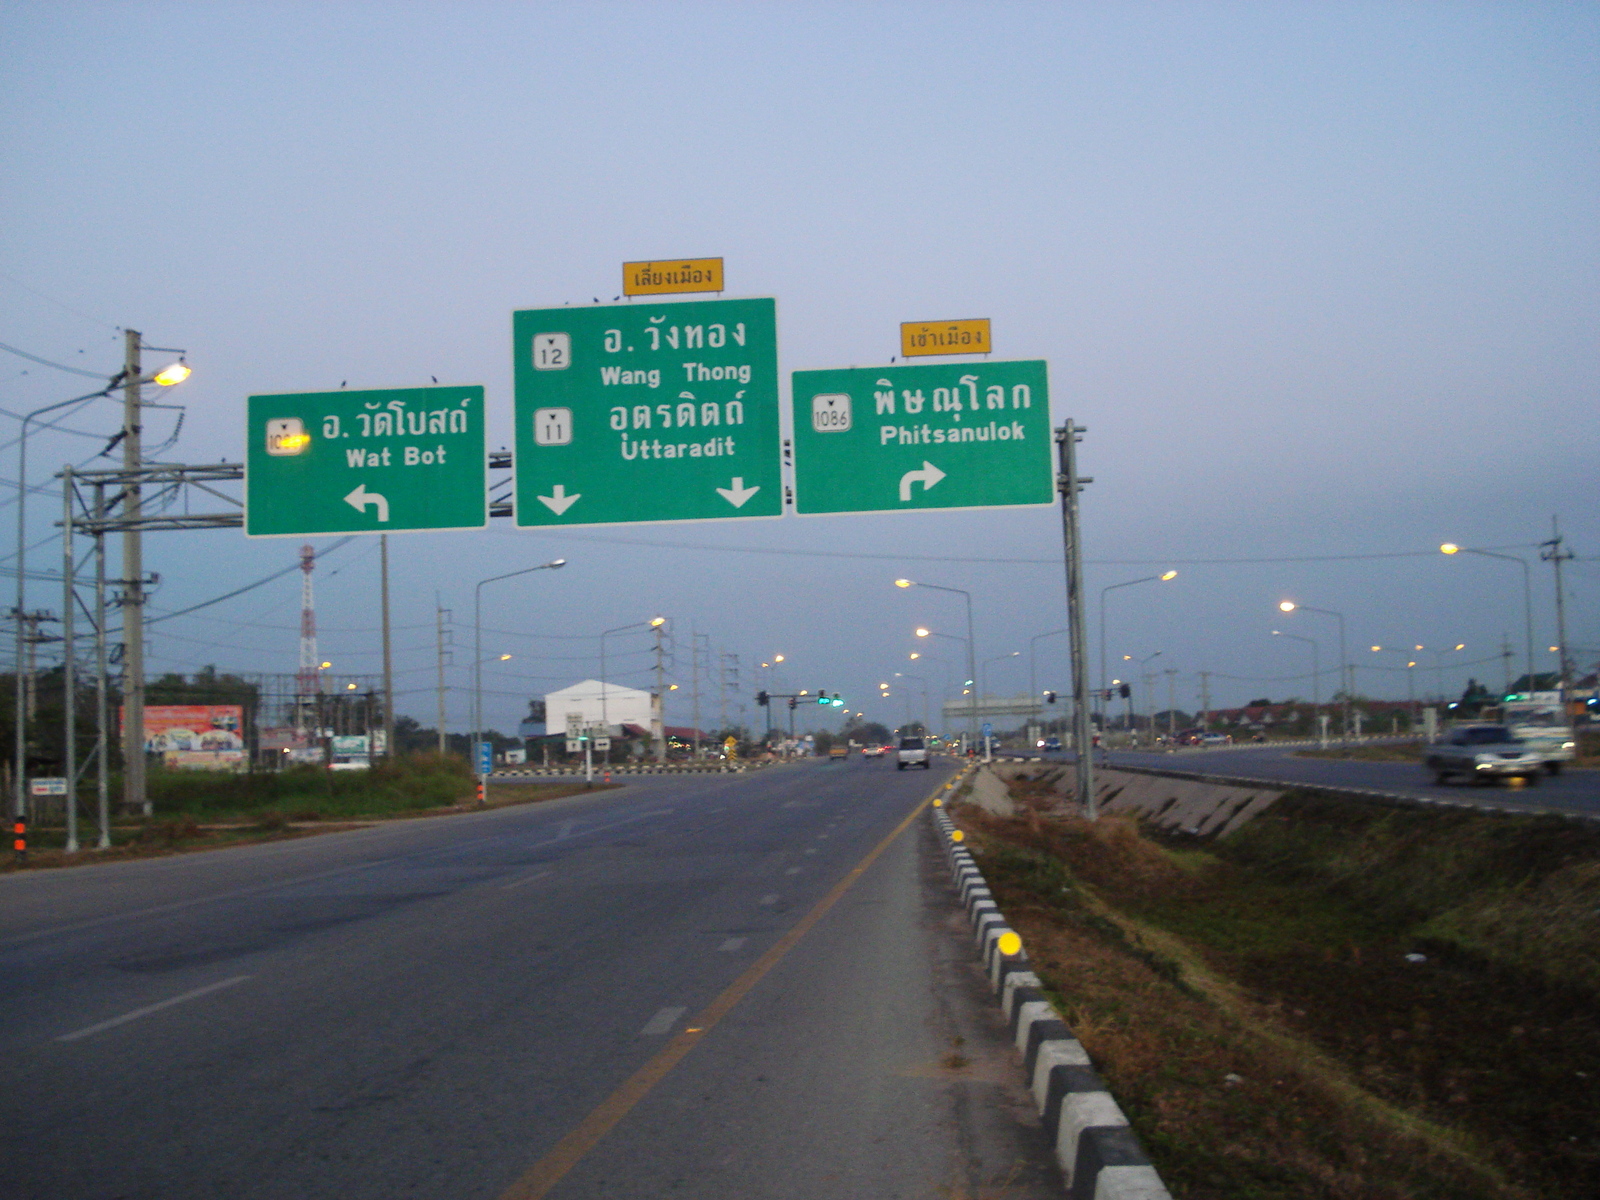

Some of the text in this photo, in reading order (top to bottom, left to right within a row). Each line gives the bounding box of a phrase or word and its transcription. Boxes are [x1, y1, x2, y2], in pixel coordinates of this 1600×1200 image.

[634, 263, 712, 286] เลี่ยงเมือง
[604, 315, 746, 353] อ. วังทอง
[911, 326, 982, 347] เข้าเมือง
[541, 348, 563, 364] 12
[601, 362, 751, 388] Wang Thong
[874, 374, 1031, 422] พิษณุโลก
[322, 398, 471, 439] อ. วัดโบสถ์
[610, 390, 746, 441] อุตรดิตถ์
[815, 410, 848, 427] 1086
[545, 424, 562, 441] 11
[880, 421, 1026, 446] Phitsanulok
[346, 444, 446, 468] Wat Bot
[621, 435, 736, 460] Uttaradit
